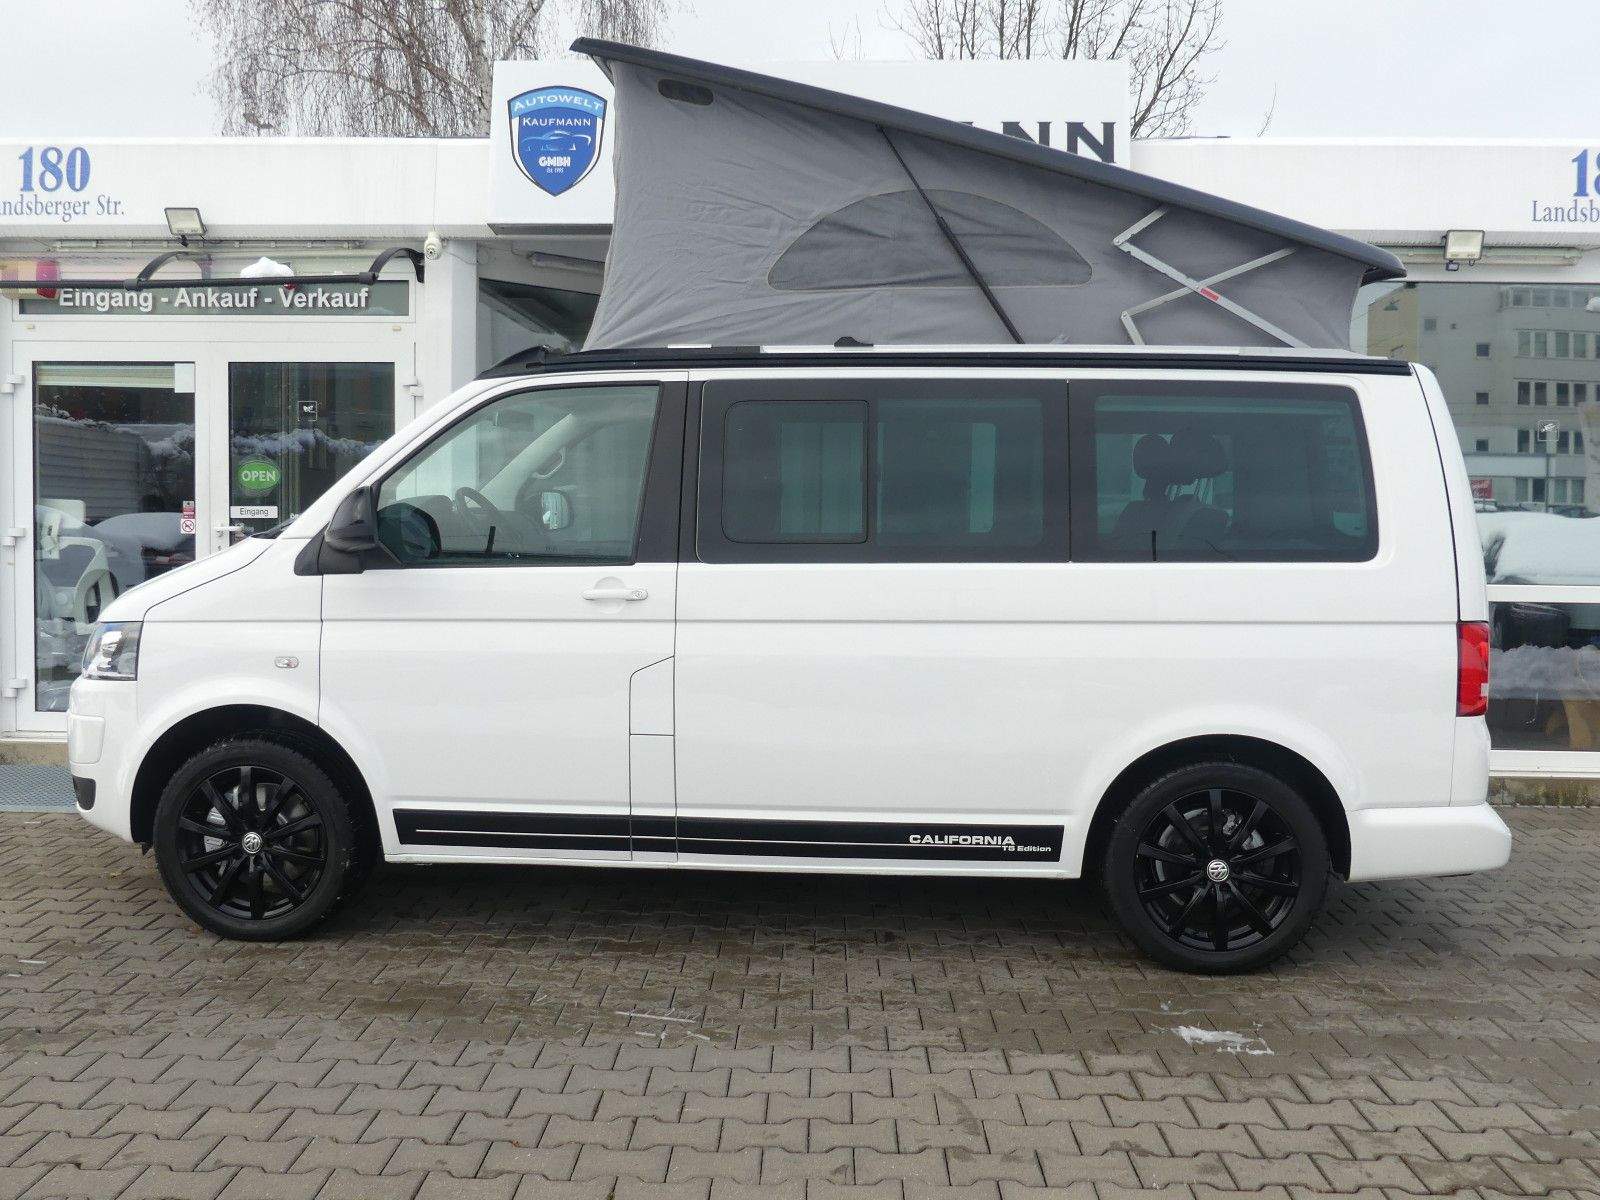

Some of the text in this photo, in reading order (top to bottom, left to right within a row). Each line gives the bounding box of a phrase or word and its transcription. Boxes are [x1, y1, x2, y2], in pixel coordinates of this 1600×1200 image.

[514, 94, 602, 112] AUTOWELT
[523, 117, 591, 127] KAUFMANN
[18, 146, 91, 192] 180
[96, 194, 125, 216] Str.
[59, 288, 153, 312] Eingang
[174, 287, 258, 308] Ankauf
[278, 287, 369, 308] Verkauf
[241, 470, 276, 482] OPEN
[239, 507, 269, 516] Eingang
[909, 834, 1016, 846] CALIFORNIA
